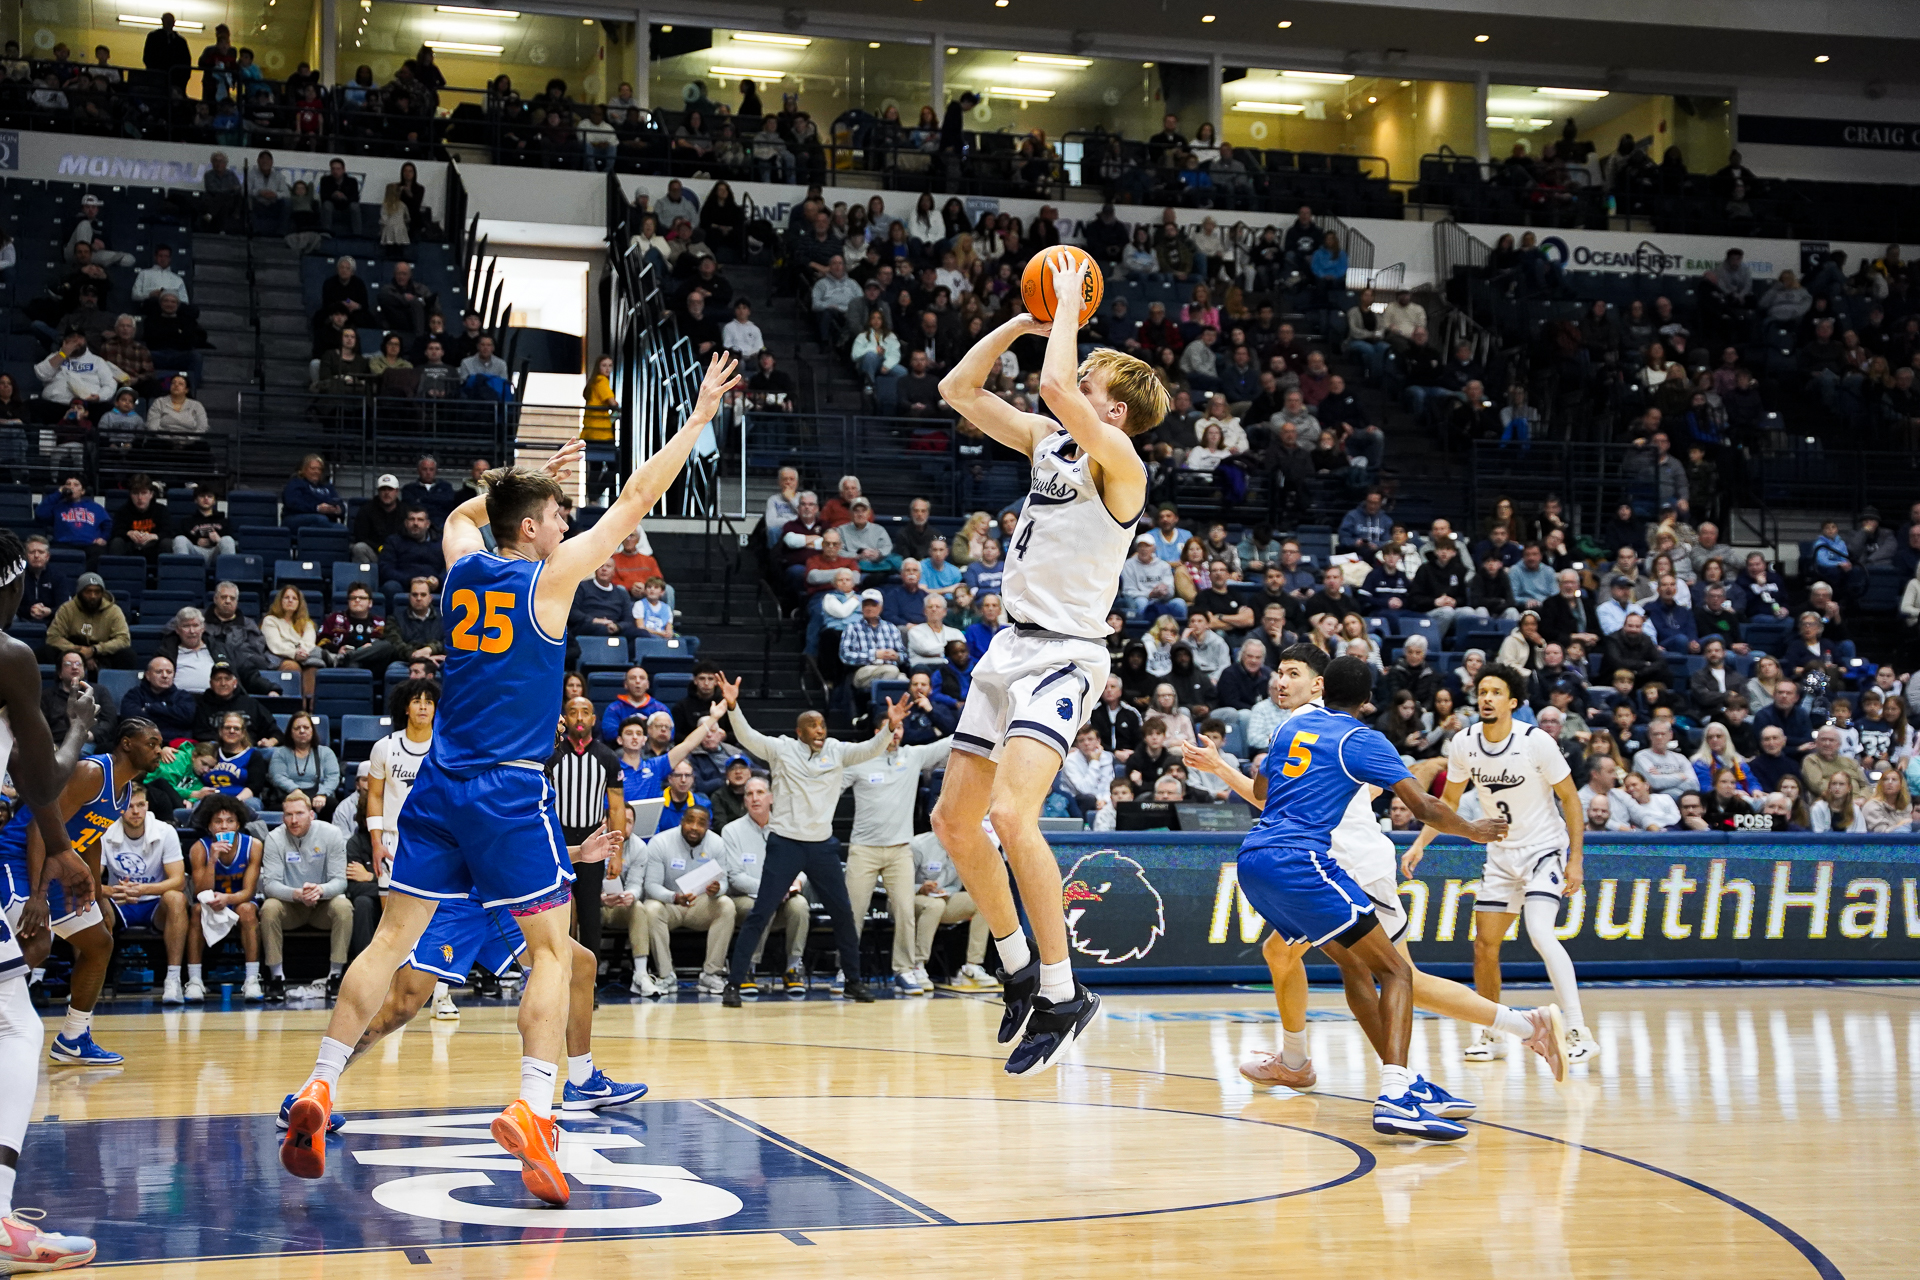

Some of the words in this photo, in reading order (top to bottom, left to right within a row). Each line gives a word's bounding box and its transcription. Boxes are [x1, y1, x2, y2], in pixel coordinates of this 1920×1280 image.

[1844, 126, 1905, 144] CRAIG
[1015, 520, 1036, 561] 4
[451, 589, 516, 654] 25
[1282, 731, 1320, 778] 5
[1471, 767, 1521, 784] Hawks
[1496, 801, 1512, 824] 3
[1733, 814, 1774, 828] POSS
